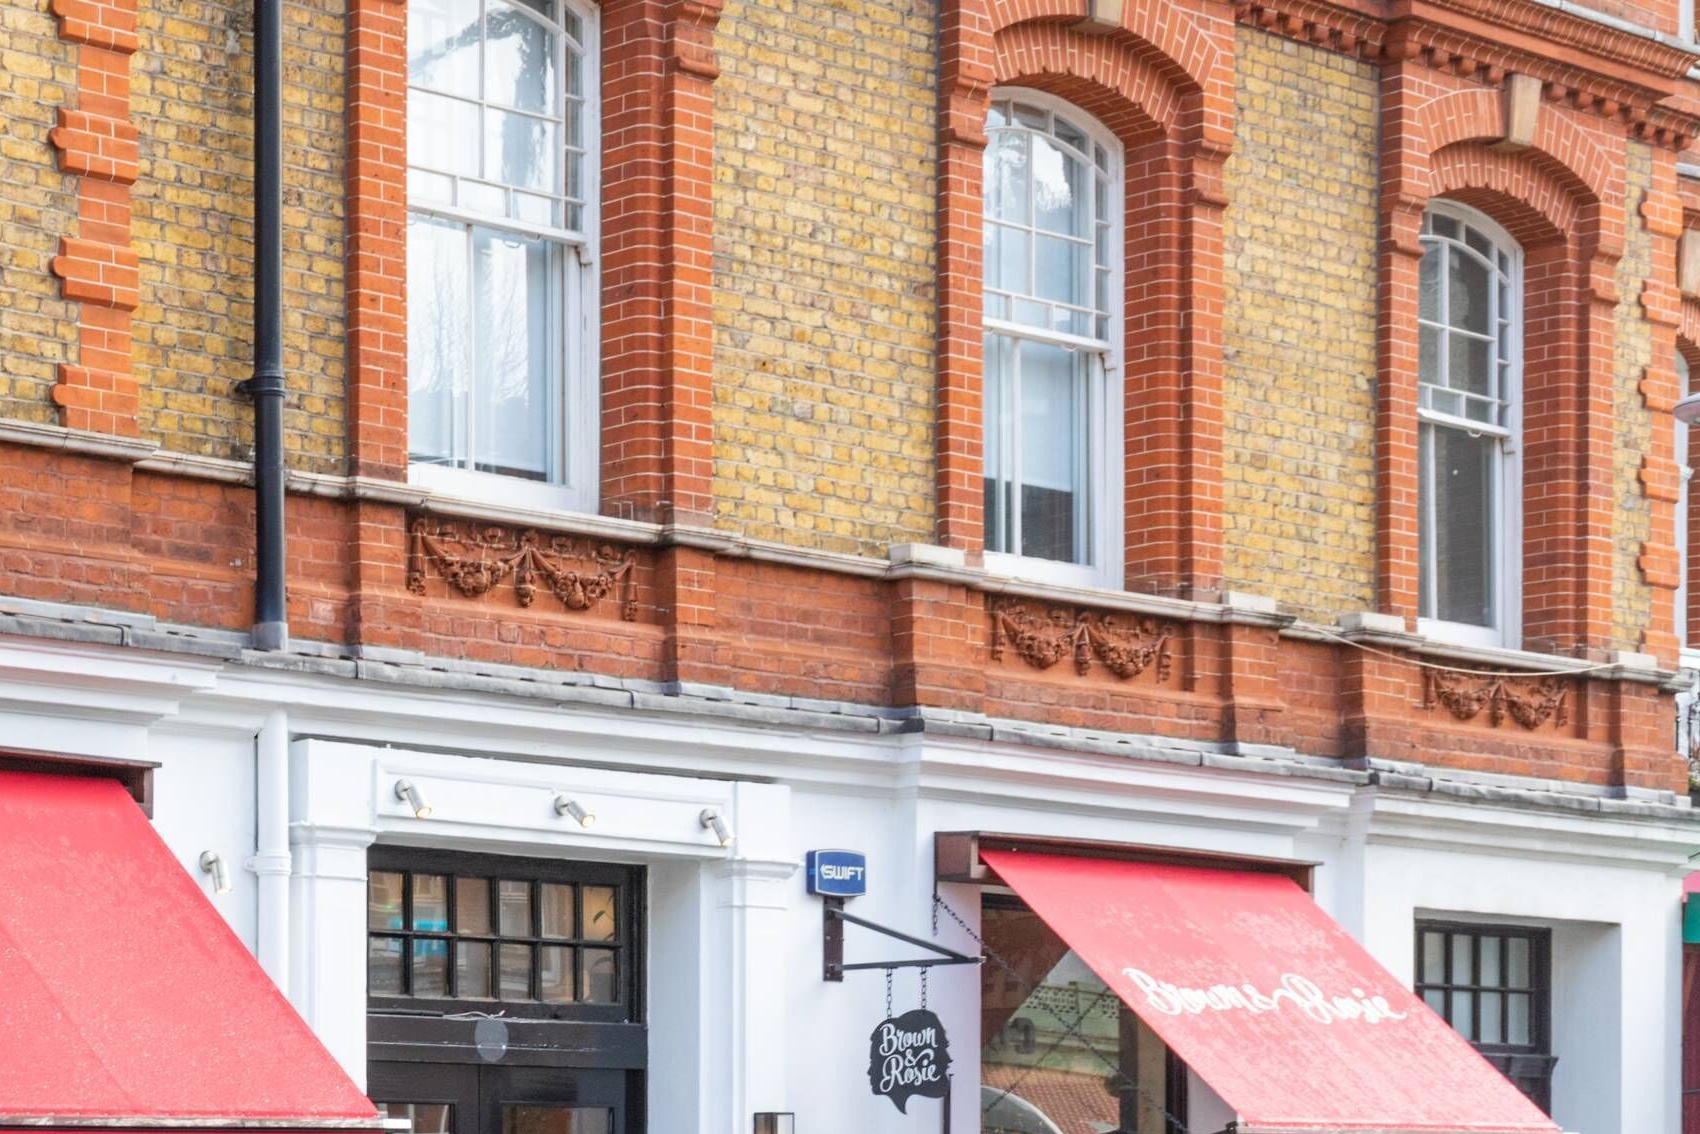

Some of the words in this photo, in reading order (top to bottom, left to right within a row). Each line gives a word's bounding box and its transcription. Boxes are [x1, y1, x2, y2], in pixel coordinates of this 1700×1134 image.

[820, 863, 864, 881] SWIFT
[878, 1022, 939, 1057] Brown
[904, 1048, 935, 1067] &
[879, 1053, 941, 1093] Rosie
